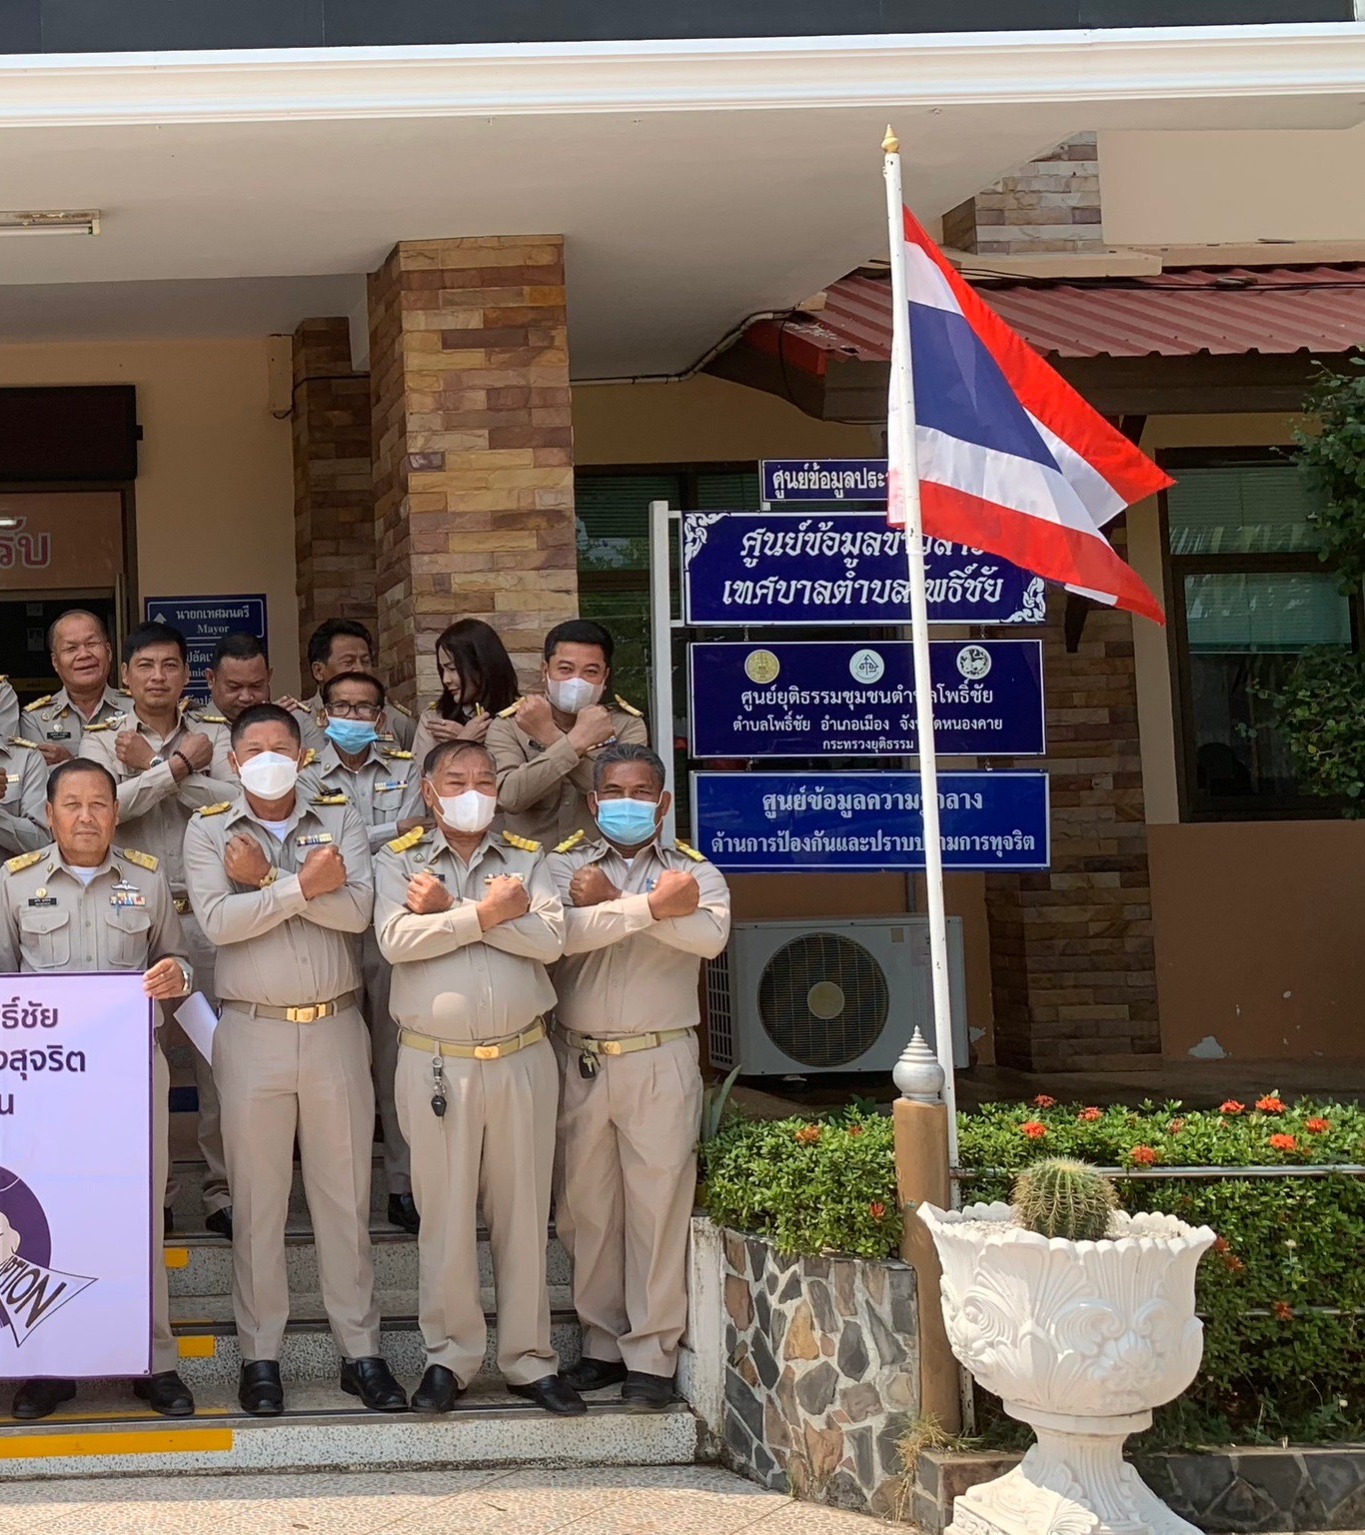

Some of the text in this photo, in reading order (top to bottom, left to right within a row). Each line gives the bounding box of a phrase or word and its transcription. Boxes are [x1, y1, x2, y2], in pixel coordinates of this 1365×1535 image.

[772, 462, 890, 499] ศูนย์ข้อมูลประ
[722, 563, 1004, 605] เทศบาลตำบลพธิ์ชัย
[176, 605, 250, 619] นายกเทศมนตรี
[197, 624, 230, 635] Mayor
[741, 677, 994, 711] ศูนย์ยุติธรรมชุมชนตำลโพธิ์ชัย
[733, 711, 811, 732] ตำบลโพธิ์ชัย
[821, 715, 890, 731] อำเภอเมือง
[823, 738, 914, 752] กระทรวงยุติธรรม
[711, 829, 1035, 858] ด้านการป้องกันและปราบปามการทุจริต
